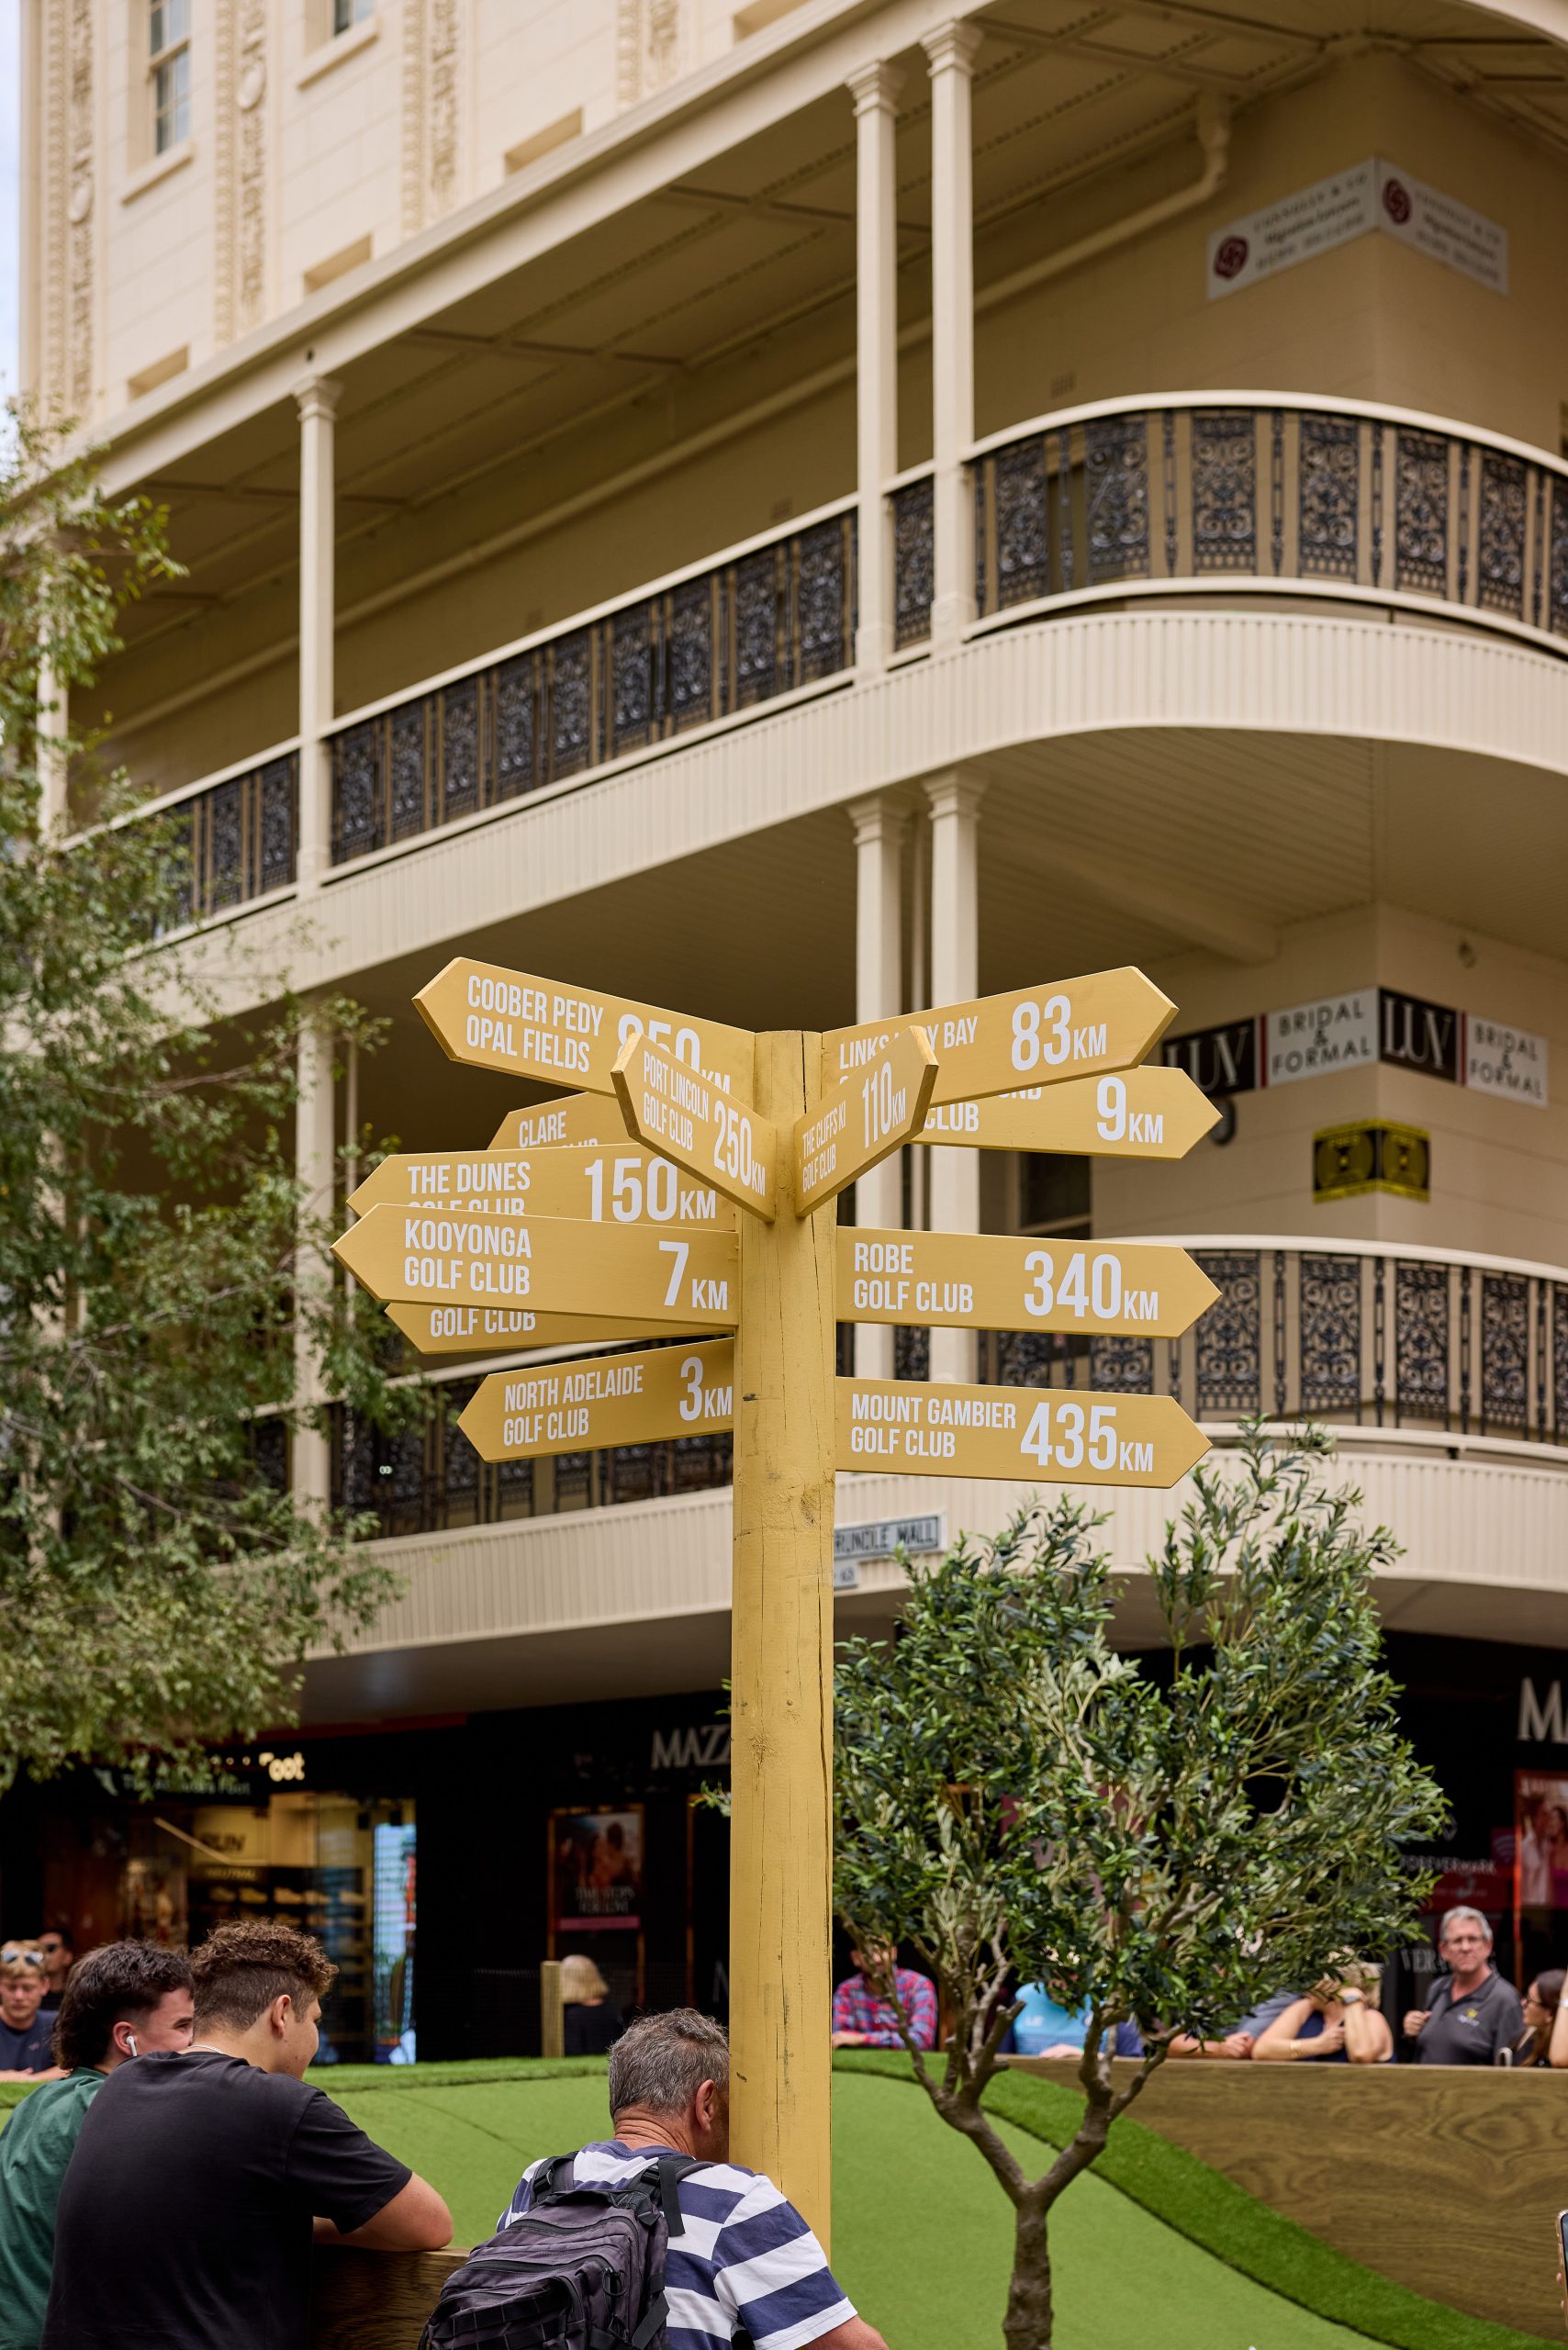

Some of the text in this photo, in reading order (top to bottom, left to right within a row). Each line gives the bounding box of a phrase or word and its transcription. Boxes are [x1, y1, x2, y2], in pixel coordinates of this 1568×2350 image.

[467, 975, 604, 1036] COOBER PEDY
[1278, 997, 1364, 1037] BRIDAL
[466, 1014, 590, 1073] OPAL FIELDS
[943, 1015, 979, 1049] BAY
[1313, 1025, 1328, 1048] &
[1474, 1022, 1540, 1062] BRIDAL
[1272, 1035, 1372, 1077] FORMAL
[644, 1051, 709, 1123] PORT LINCOLN
[1470, 1057, 1543, 1100] FORMAL
[519, 1111, 567, 1148] CLARE
[644, 1091, 693, 1152] GOLF CLUB
[802, 1101, 847, 1160] THE CLIFFS KI
[924, 1102, 980, 1132] CLUB
[408, 1161, 531, 1194] THE DUNES
[802, 1144, 836, 1193] GOLF CLUB
[405, 1218, 532, 1259] KOOYONGA
[853, 1242, 914, 1274] ROBE
[404, 1256, 531, 1295] GOLF CLUB
[658, 1240, 728, 1311] 7 KM
[853, 1279, 974, 1314] GOLF CLUB
[430, 1308, 536, 1337] GOLF CLUB
[504, 1364, 644, 1414] NORTH ADELAIDE
[503, 1407, 589, 1447] GOLF CLUB
[852, 1393, 1016, 1429] MOUNT GAMBIER
[851, 1427, 956, 1459] GOLF CLUB
